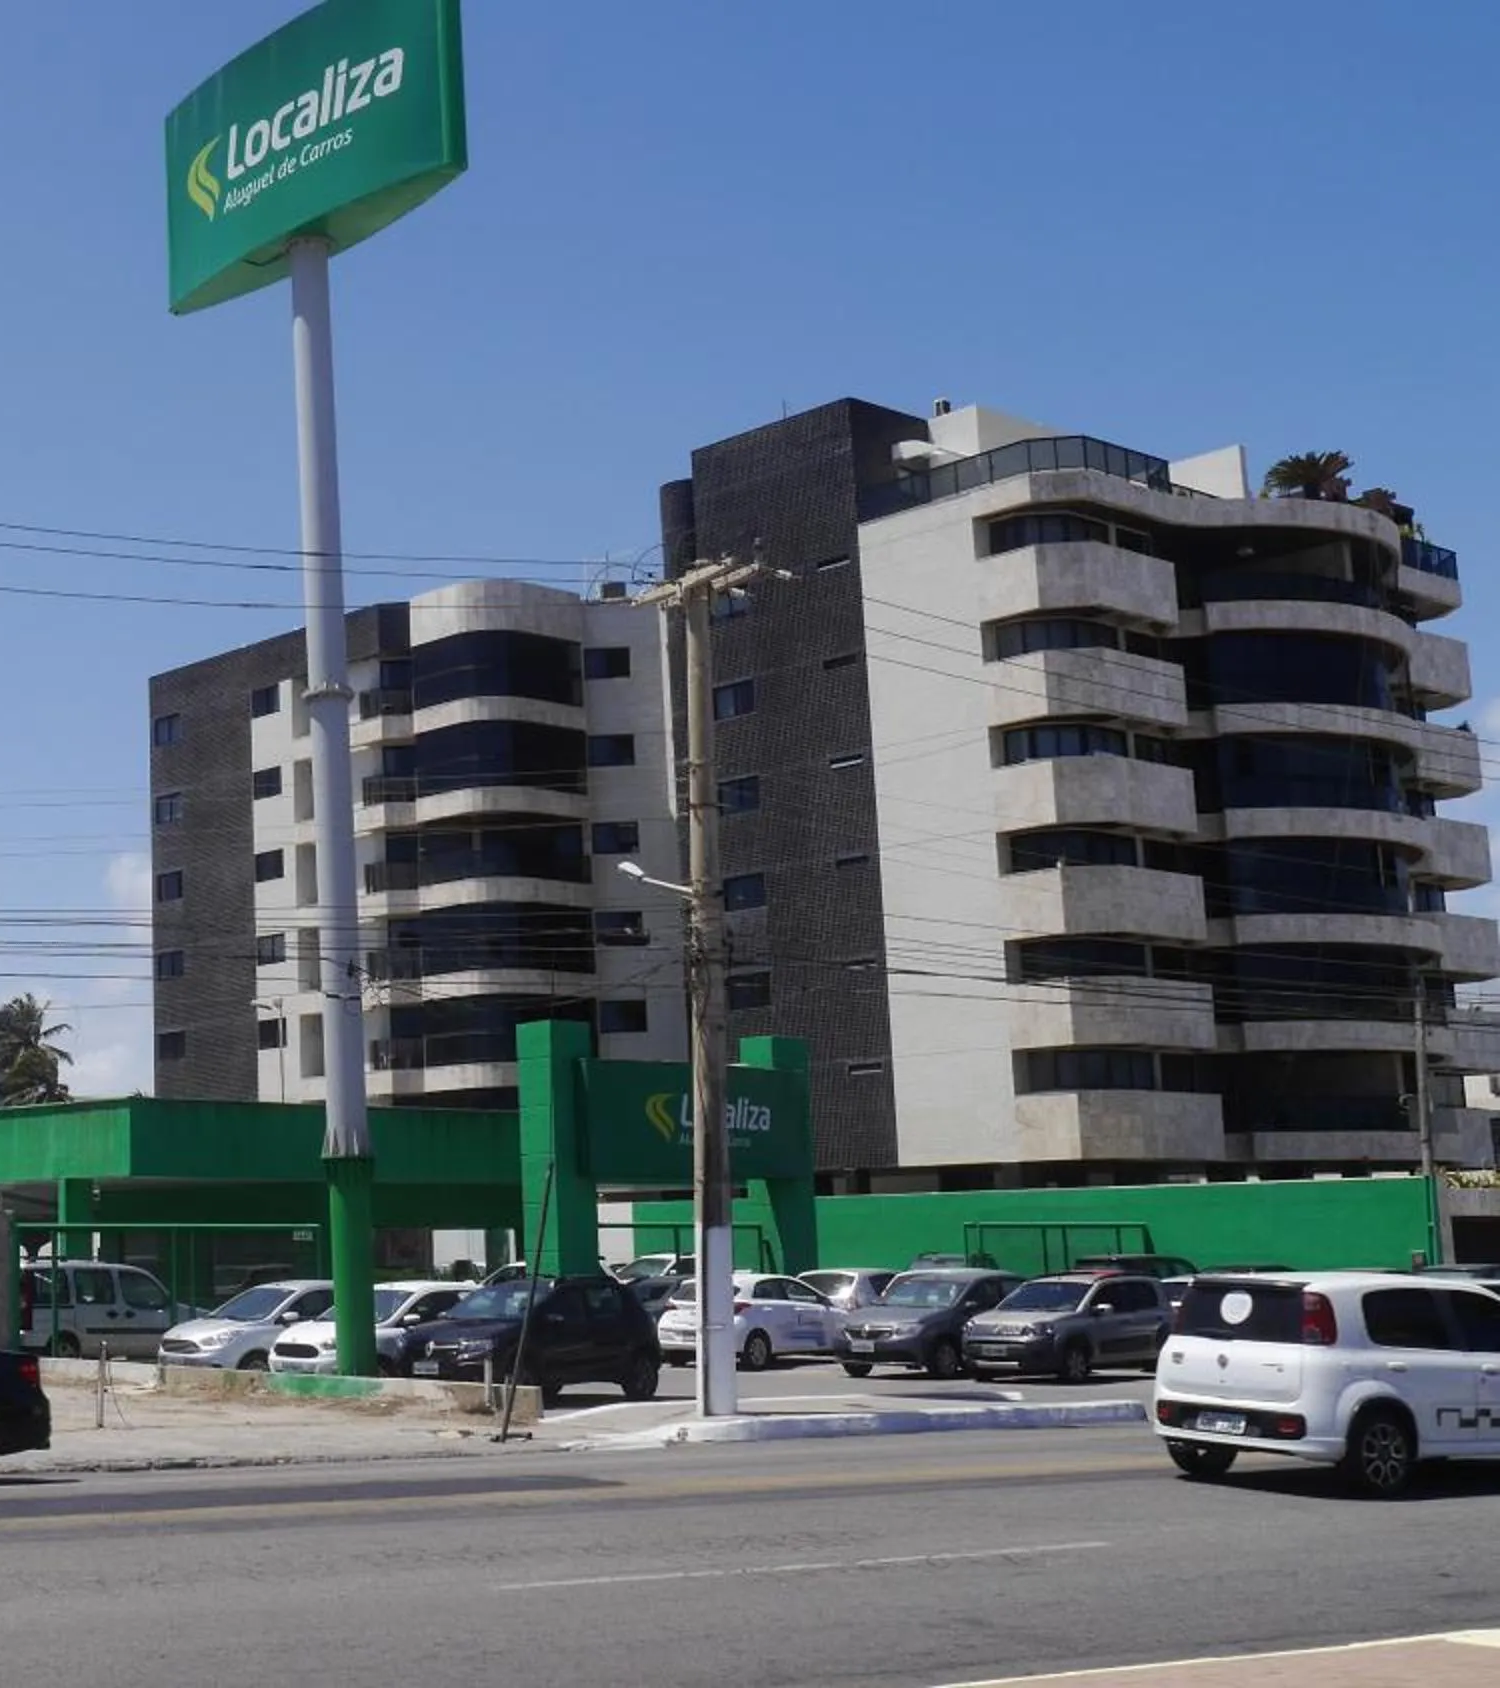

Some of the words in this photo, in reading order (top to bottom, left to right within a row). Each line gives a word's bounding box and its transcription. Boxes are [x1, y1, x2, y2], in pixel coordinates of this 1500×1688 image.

[226, 47, 404, 180] Localiza
[223, 163, 275, 214] Aluguel
[277, 154, 298, 180] de
[300, 127, 353, 167] Carros
[680, 1092, 772, 1131] Laliza
